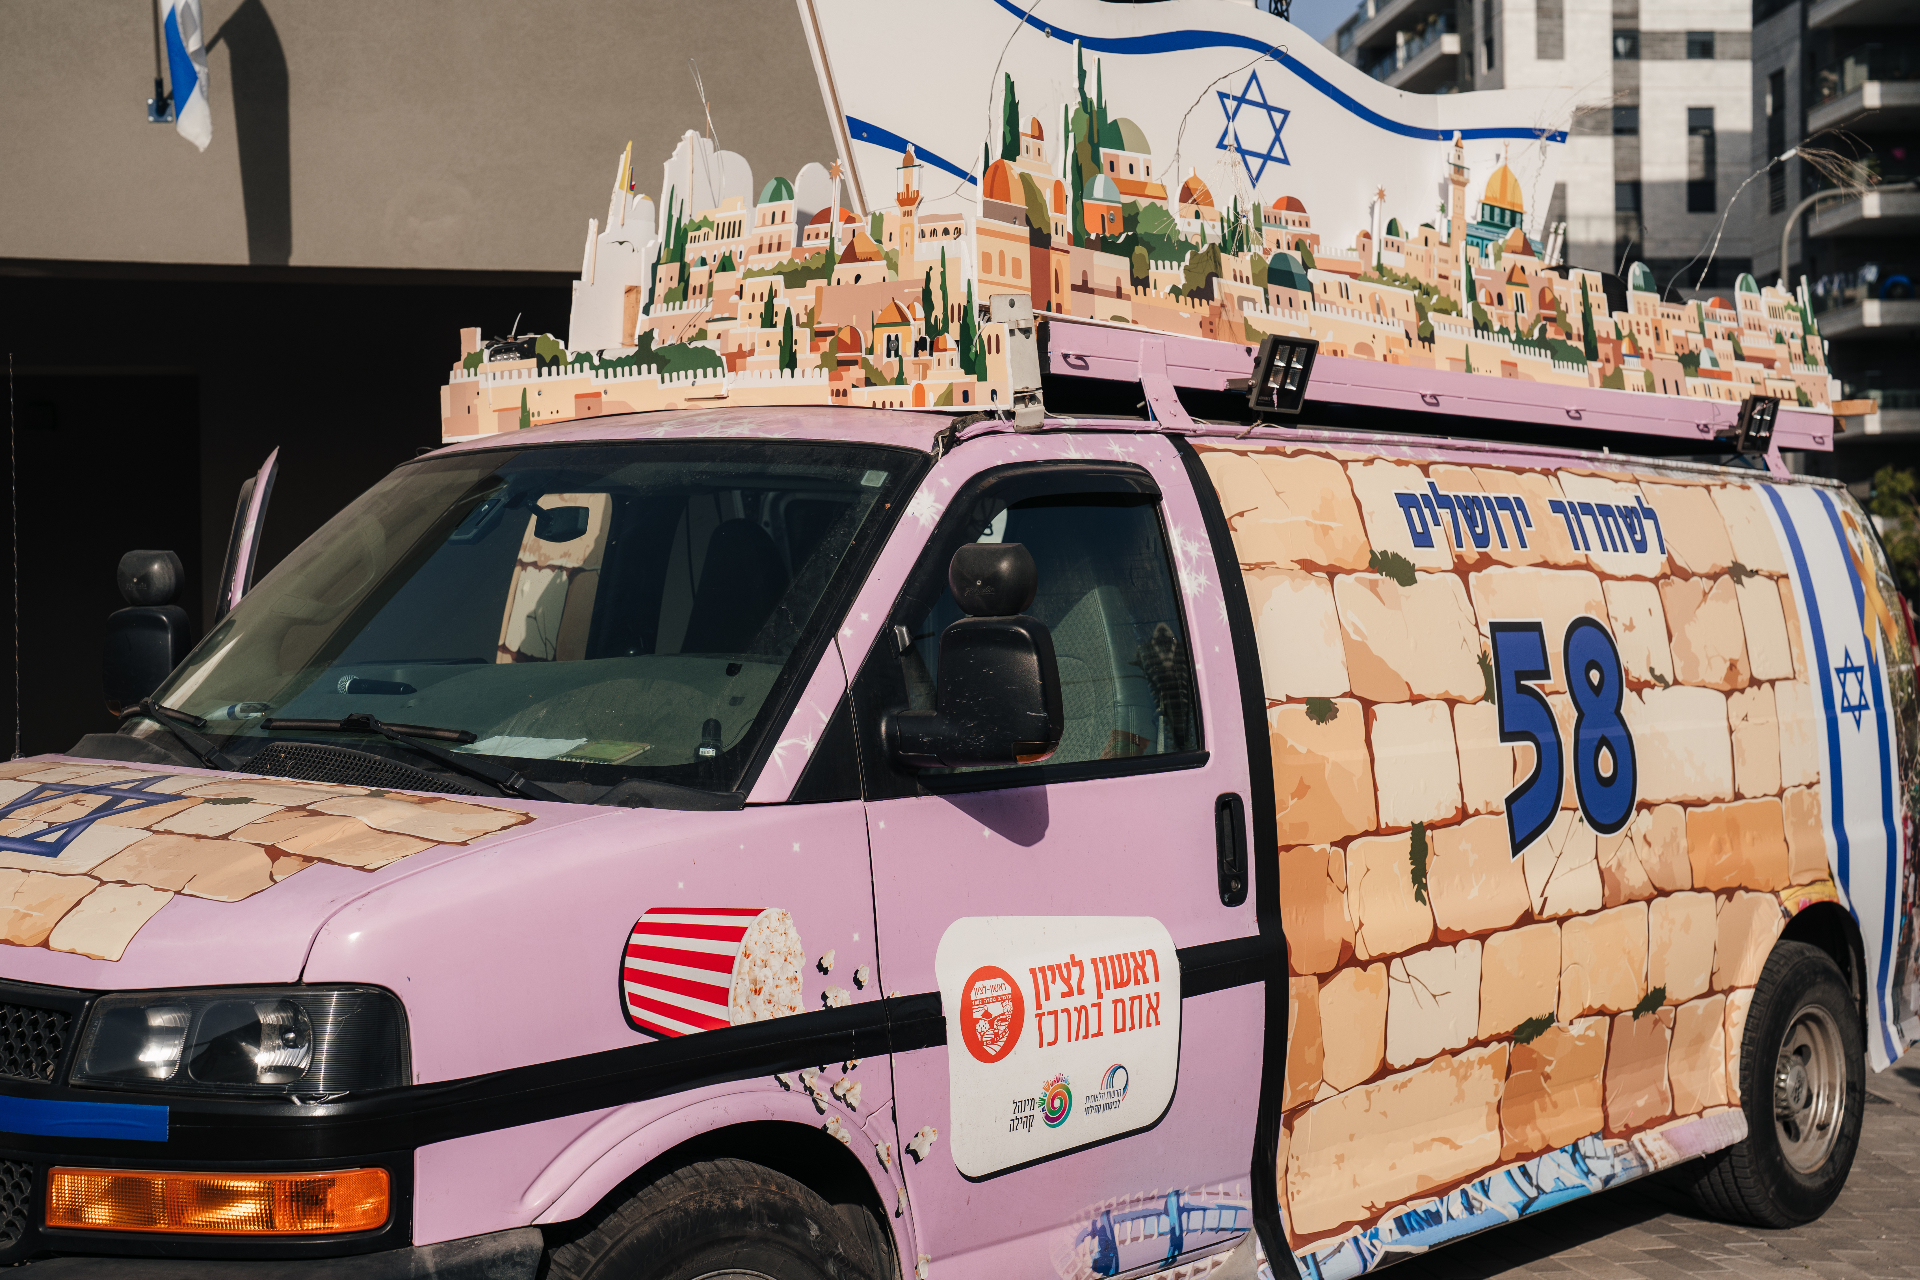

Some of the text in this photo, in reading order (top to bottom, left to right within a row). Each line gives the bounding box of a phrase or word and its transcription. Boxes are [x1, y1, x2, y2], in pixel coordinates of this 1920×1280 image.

[1394, 479, 1667, 555] לשחרור ירושלים
[1488, 616, 1638, 861] 58
[1029, 949, 1160, 1011] ראשון לציון
[1035, 992, 1161, 1048] אתם במרכז
[1009, 1114, 1035, 1133] קהילה
[1013, 1097, 1036, 1114] מינהל
